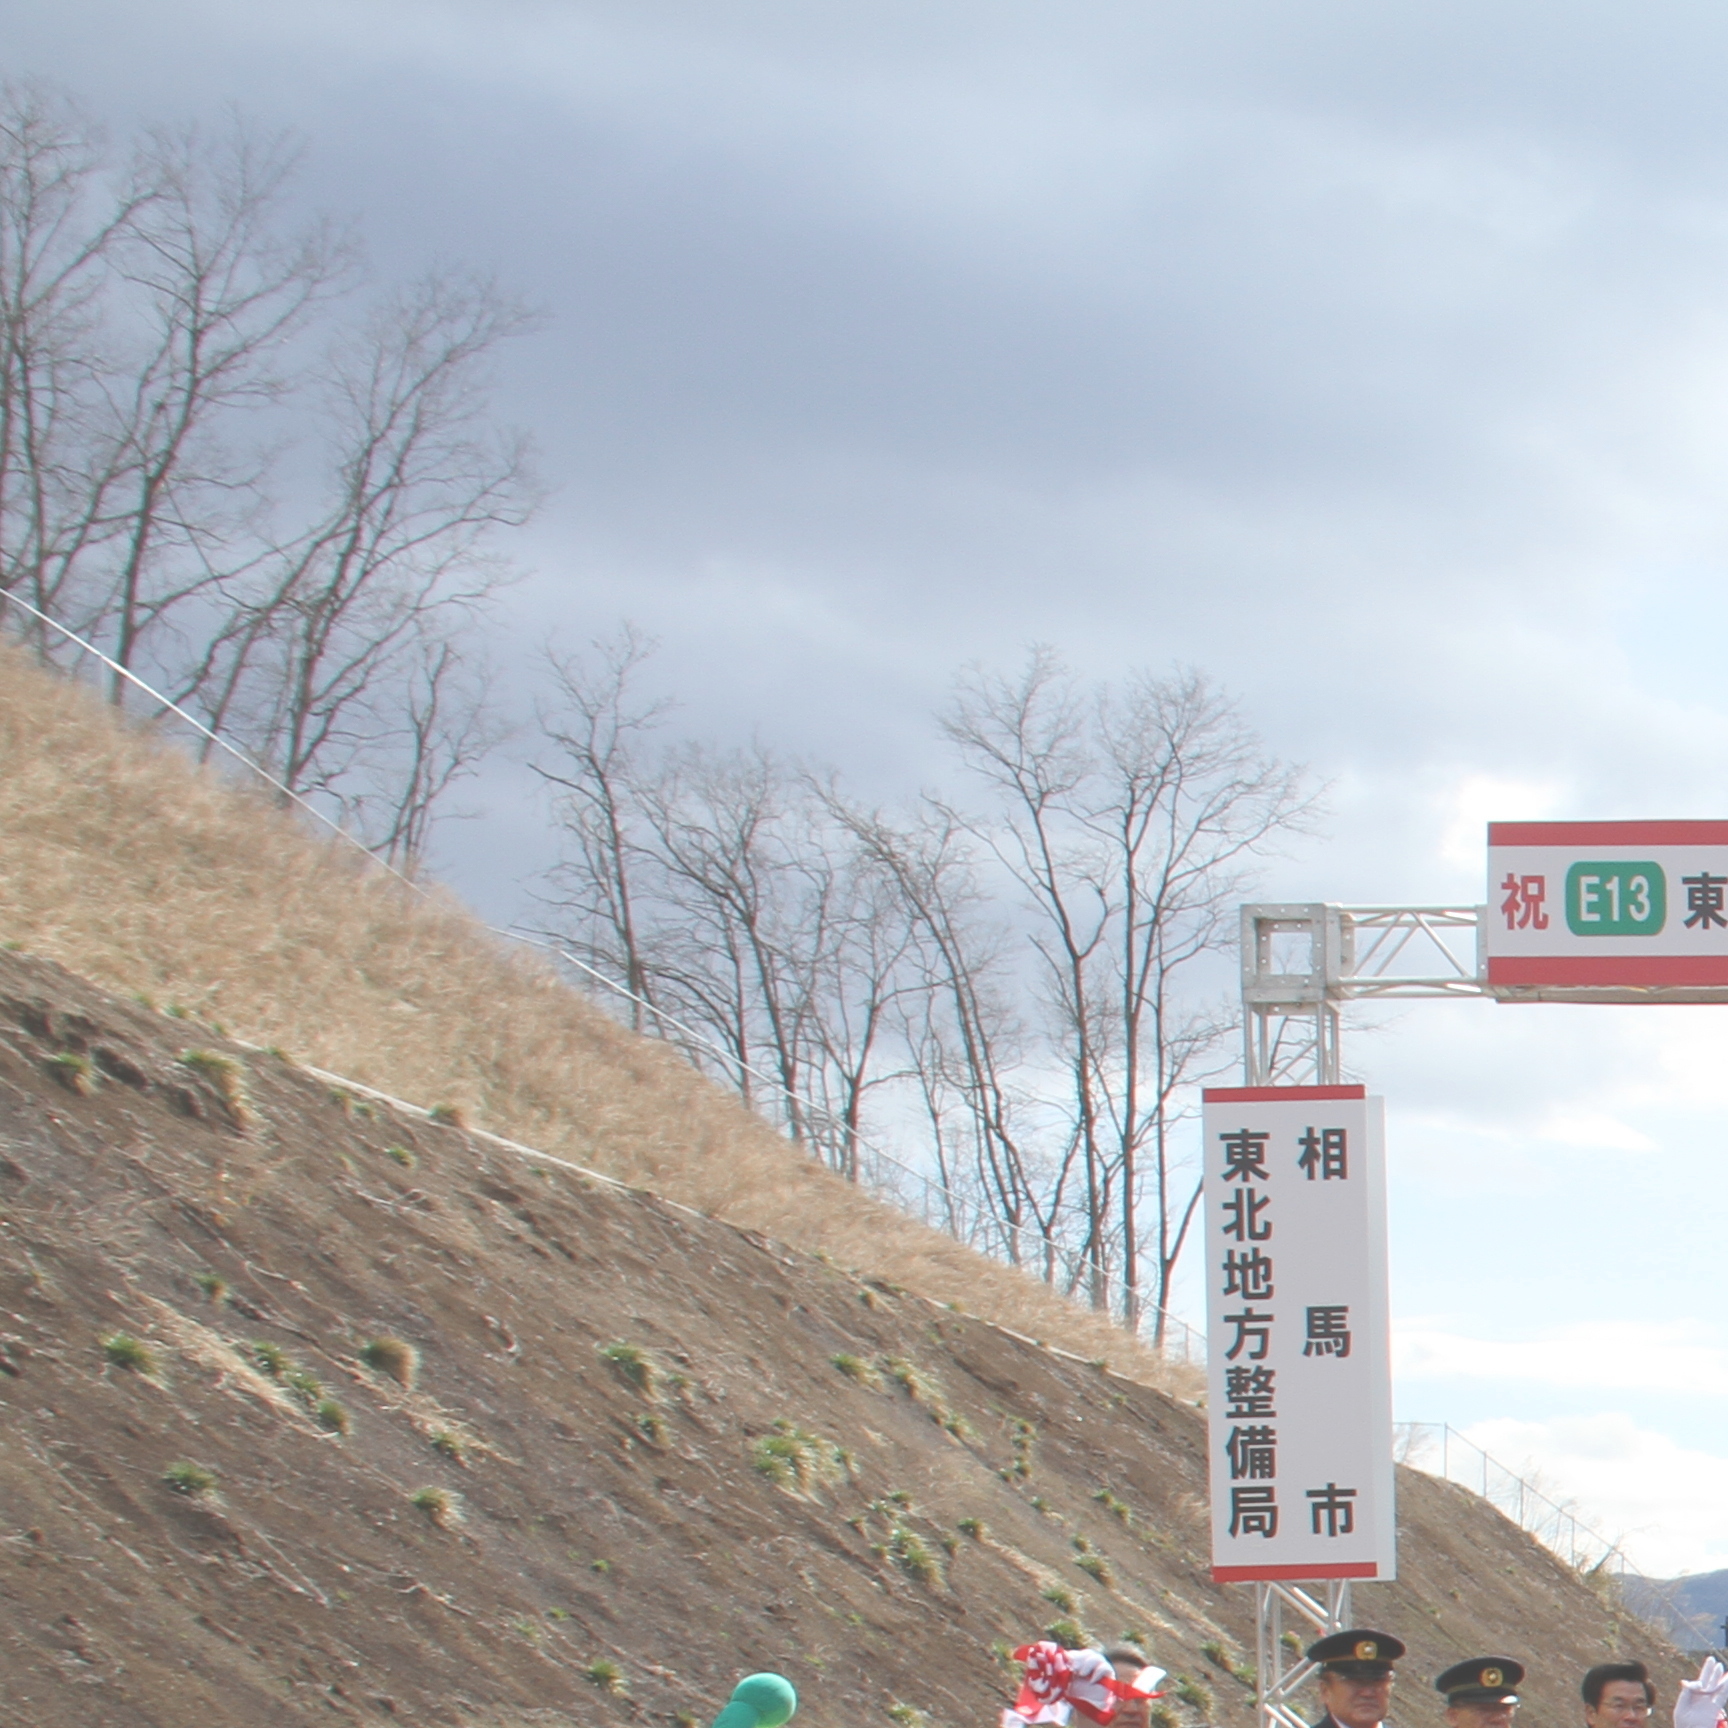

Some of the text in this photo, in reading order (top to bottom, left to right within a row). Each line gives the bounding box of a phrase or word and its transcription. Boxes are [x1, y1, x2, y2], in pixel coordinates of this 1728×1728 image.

[1500, 872, 1548, 930] 祝
[1580, 875, 1653, 920] E13
[1219, 1127, 1279, 1540] 東北地方整備局
[1298, 1126, 1357, 1538] 相馬市
